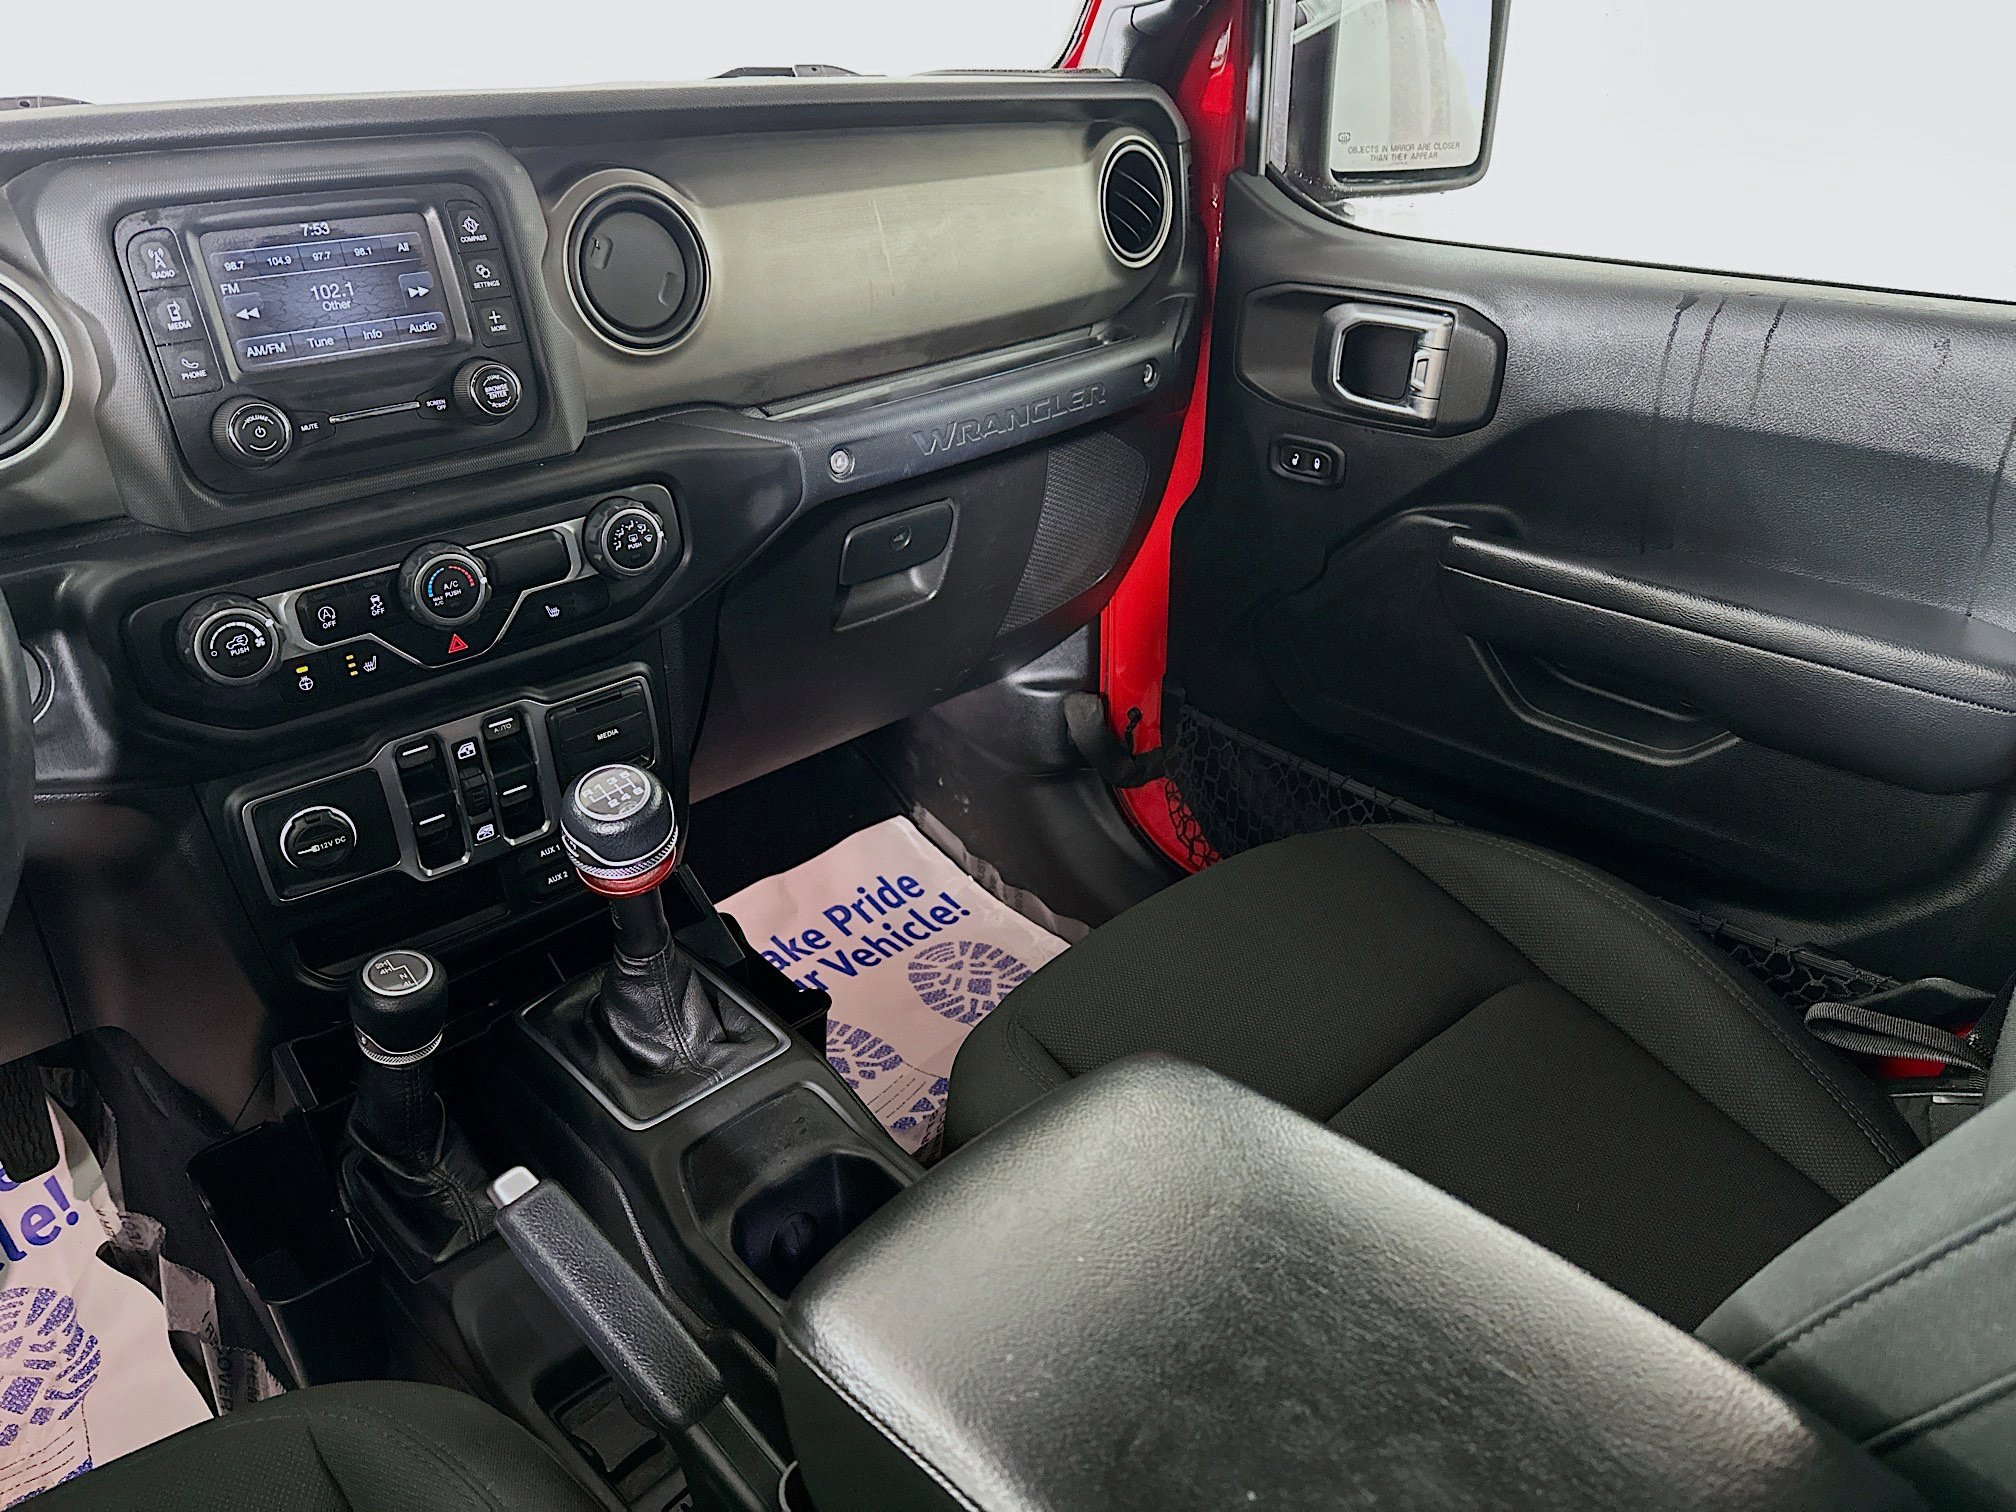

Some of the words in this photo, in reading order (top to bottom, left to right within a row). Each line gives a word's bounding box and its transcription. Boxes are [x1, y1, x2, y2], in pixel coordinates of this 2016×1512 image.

[1348, 146, 1378, 154] OBJECTS
[1382, 145, 1388, 153] IN
[1390, 144, 1414, 152] MIRROR
[1433, 141, 1460, 150] CLOSER
[1391, 153, 1407, 161] THEY
[1410, 152, 1438, 160] APPEAR
[300, 222, 330, 236] 7:53
[460, 234, 488, 243] COMPASS
[224, 260, 244, 271] 98.7
[267, 256, 292, 266] 104.9
[312, 251, 331, 261] 97.7
[398, 242, 410, 252] All
[151, 270, 175, 279] RADIO
[220, 282, 240, 295] FM
[473, 280, 500, 289] SETTINGS
[310, 281, 355, 300] 102.1
[322, 300, 351, 312] Other
[168, 320, 192, 331] MEDIA
[490, 324, 507, 332] MORE
[247, 342, 287, 357] AM/FM
[307, 336, 334, 348] Tune
[363, 329, 383, 340] Info
[409, 321, 437, 334] Audio
[182, 370, 208, 380] PHONE
[484, 383, 508, 392] BROWSE
[488, 391, 507, 400] ENTER
[245, 414, 269, 423] VOLUME
[912, 382, 1106, 456] WRANGLER
[300, 423, 319, 432] MUTE
[628, 542, 642, 550] PUSH
[444, 580, 458, 590] A/C
[445, 589, 462, 598] PUSH
[371, 607, 385, 616] OFF
[322, 620, 336, 629] OFF
[230, 646, 250, 657] PUSH
[597, 728, 619, 741] MEDIA
[320, 840, 333, 850] 12V
[335, 836, 347, 845] DC
[540, 846, 556, 858] AUX
[548, 873, 563, 884] AUX
[761, 929, 832, 970] ake
[822, 875, 925, 937] Pride
[817, 892, 971, 977] Vehicle!
[374, 961, 388, 970] 2H
[380, 966, 393, 975] 4H
[399, 972, 408, 980] N
[403, 979, 415, 987] 4L
